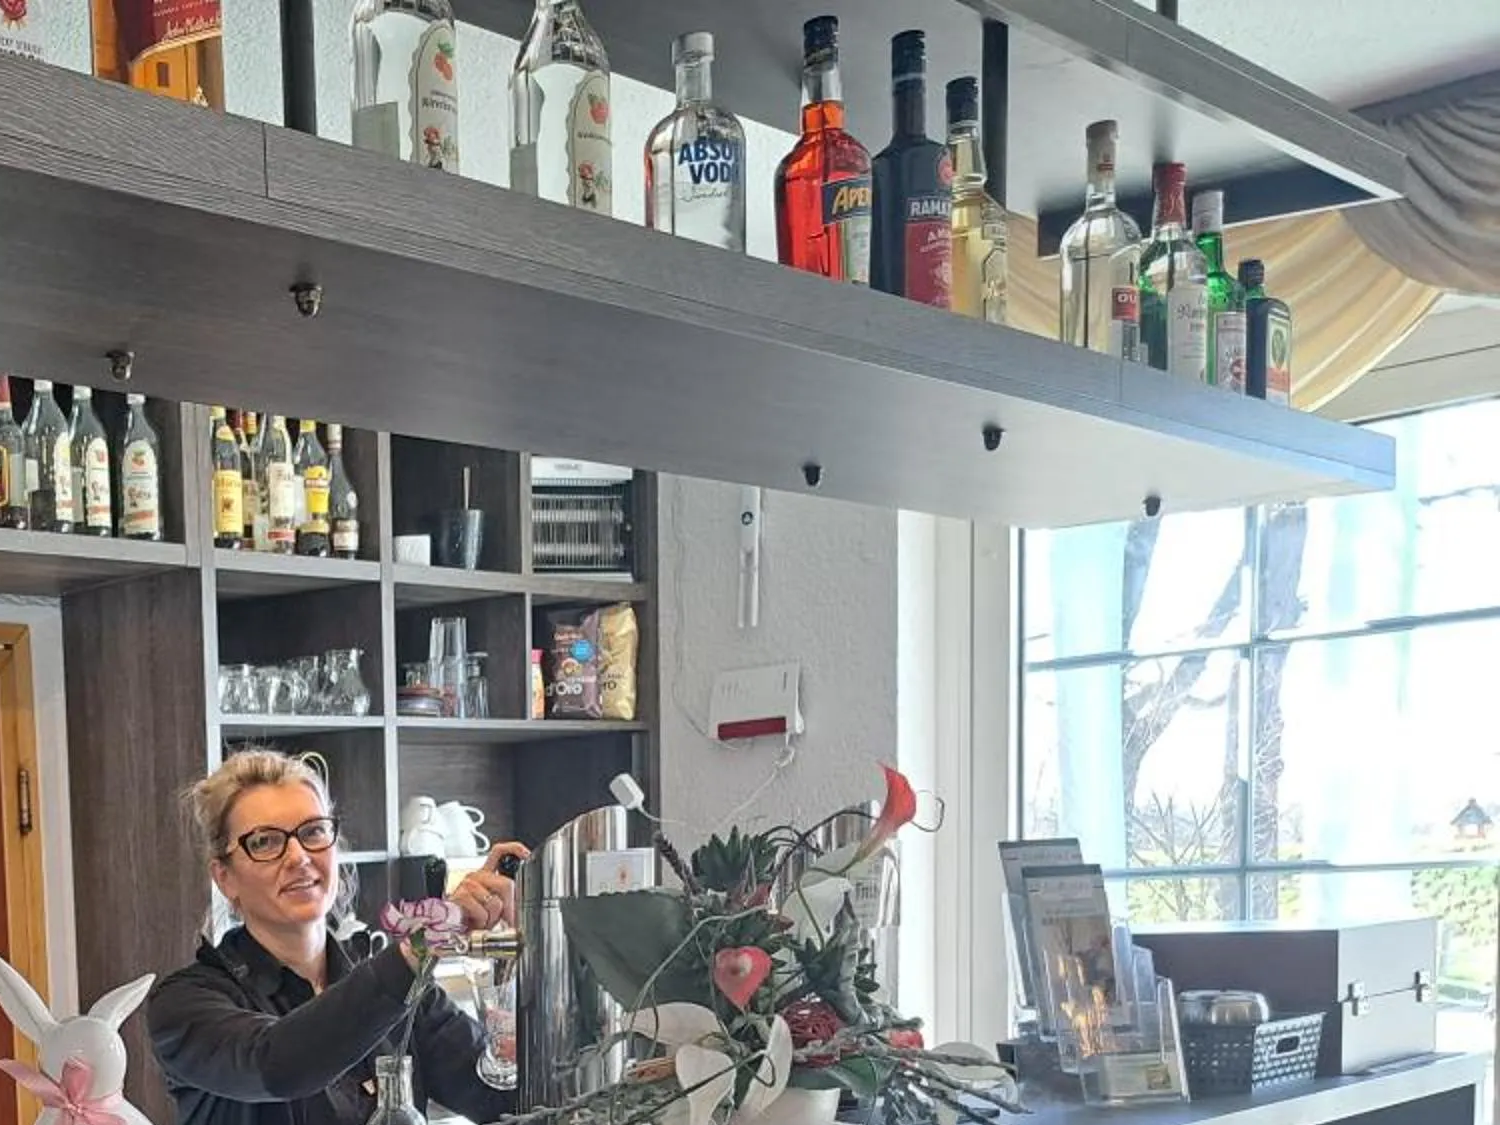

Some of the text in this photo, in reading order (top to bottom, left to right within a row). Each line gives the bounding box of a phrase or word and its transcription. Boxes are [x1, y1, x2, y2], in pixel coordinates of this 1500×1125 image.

[689, 162, 738, 184] VOD
[832, 186, 869, 215] APE
[1118, 293, 1138, 305] OU
